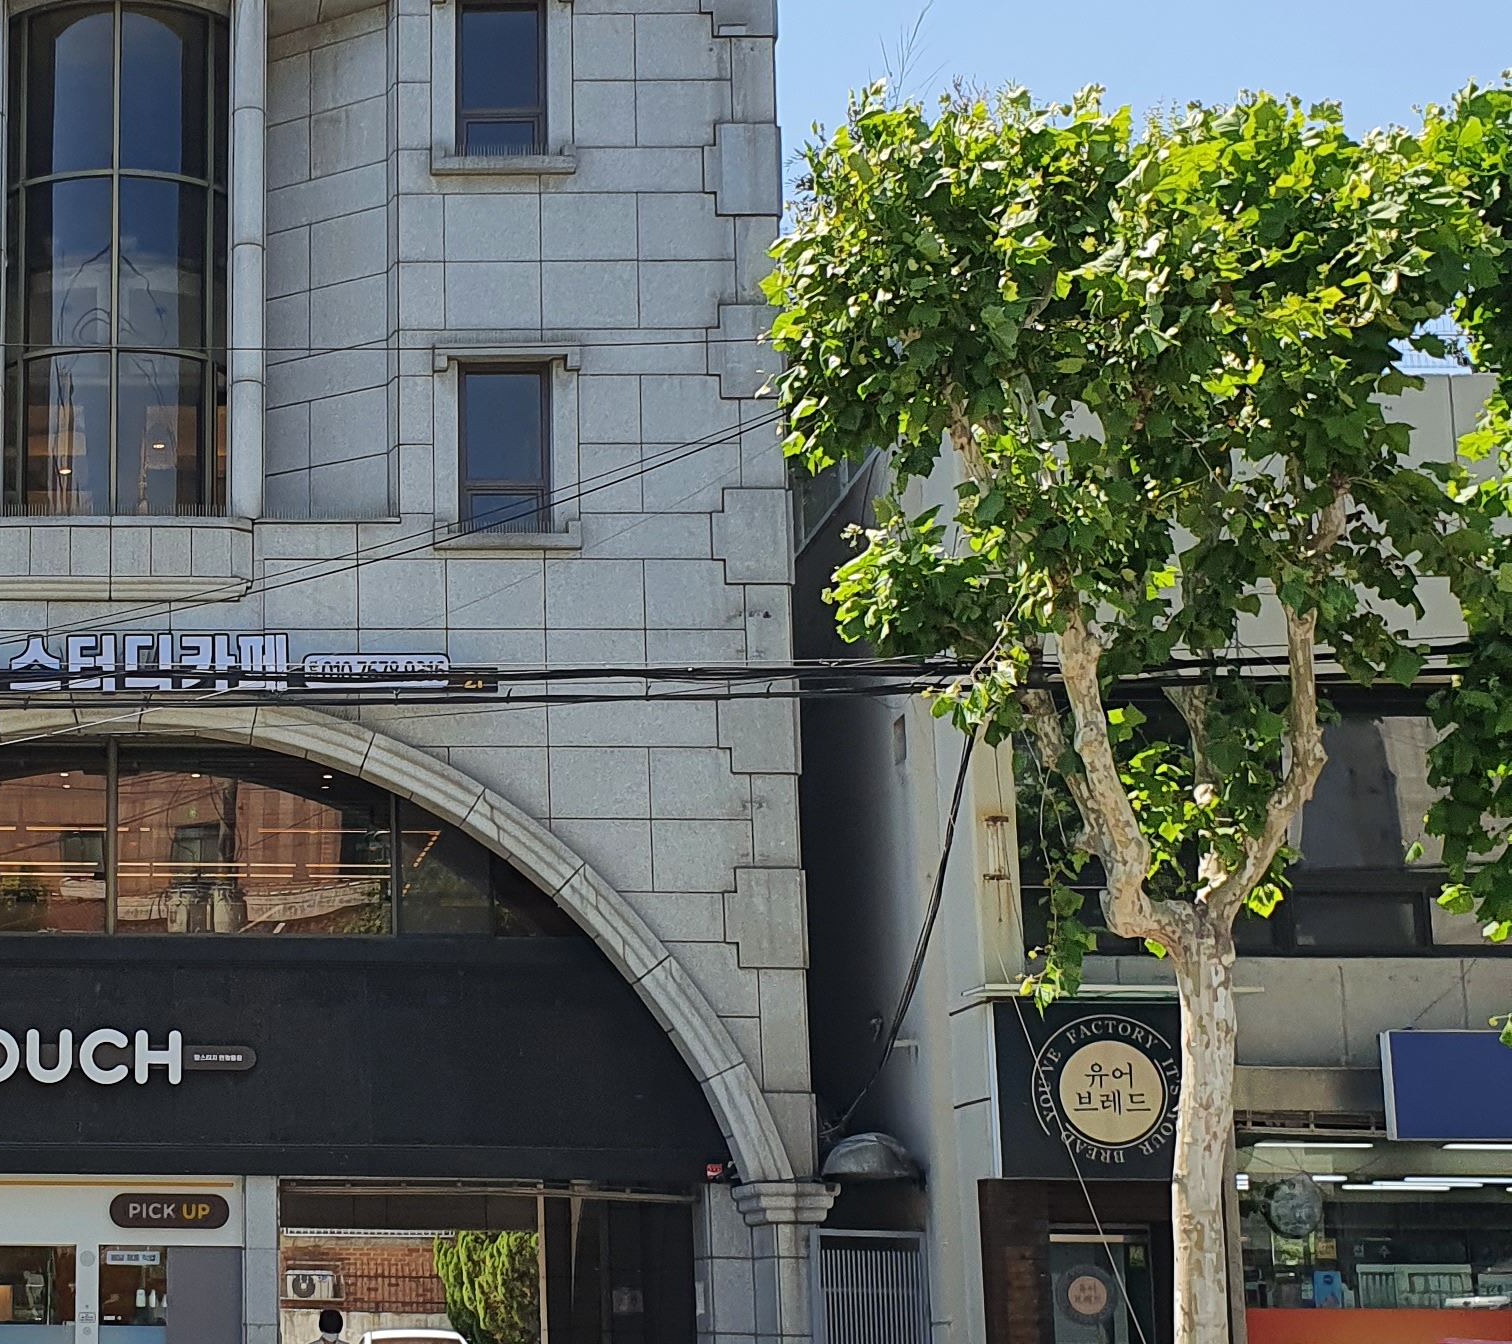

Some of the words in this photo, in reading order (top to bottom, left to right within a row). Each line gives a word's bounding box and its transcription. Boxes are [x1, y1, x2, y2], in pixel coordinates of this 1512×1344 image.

[9, 633, 289, 692] 스터디카페
[1065, 1020, 1159, 1050] FACTORY
[1084, 1061, 1133, 1089] 유어
[1073, 1089, 1152, 1116] 브레드
[129, 1203, 176, 1219] PICK
[181, 1203, 210, 1220] UP
